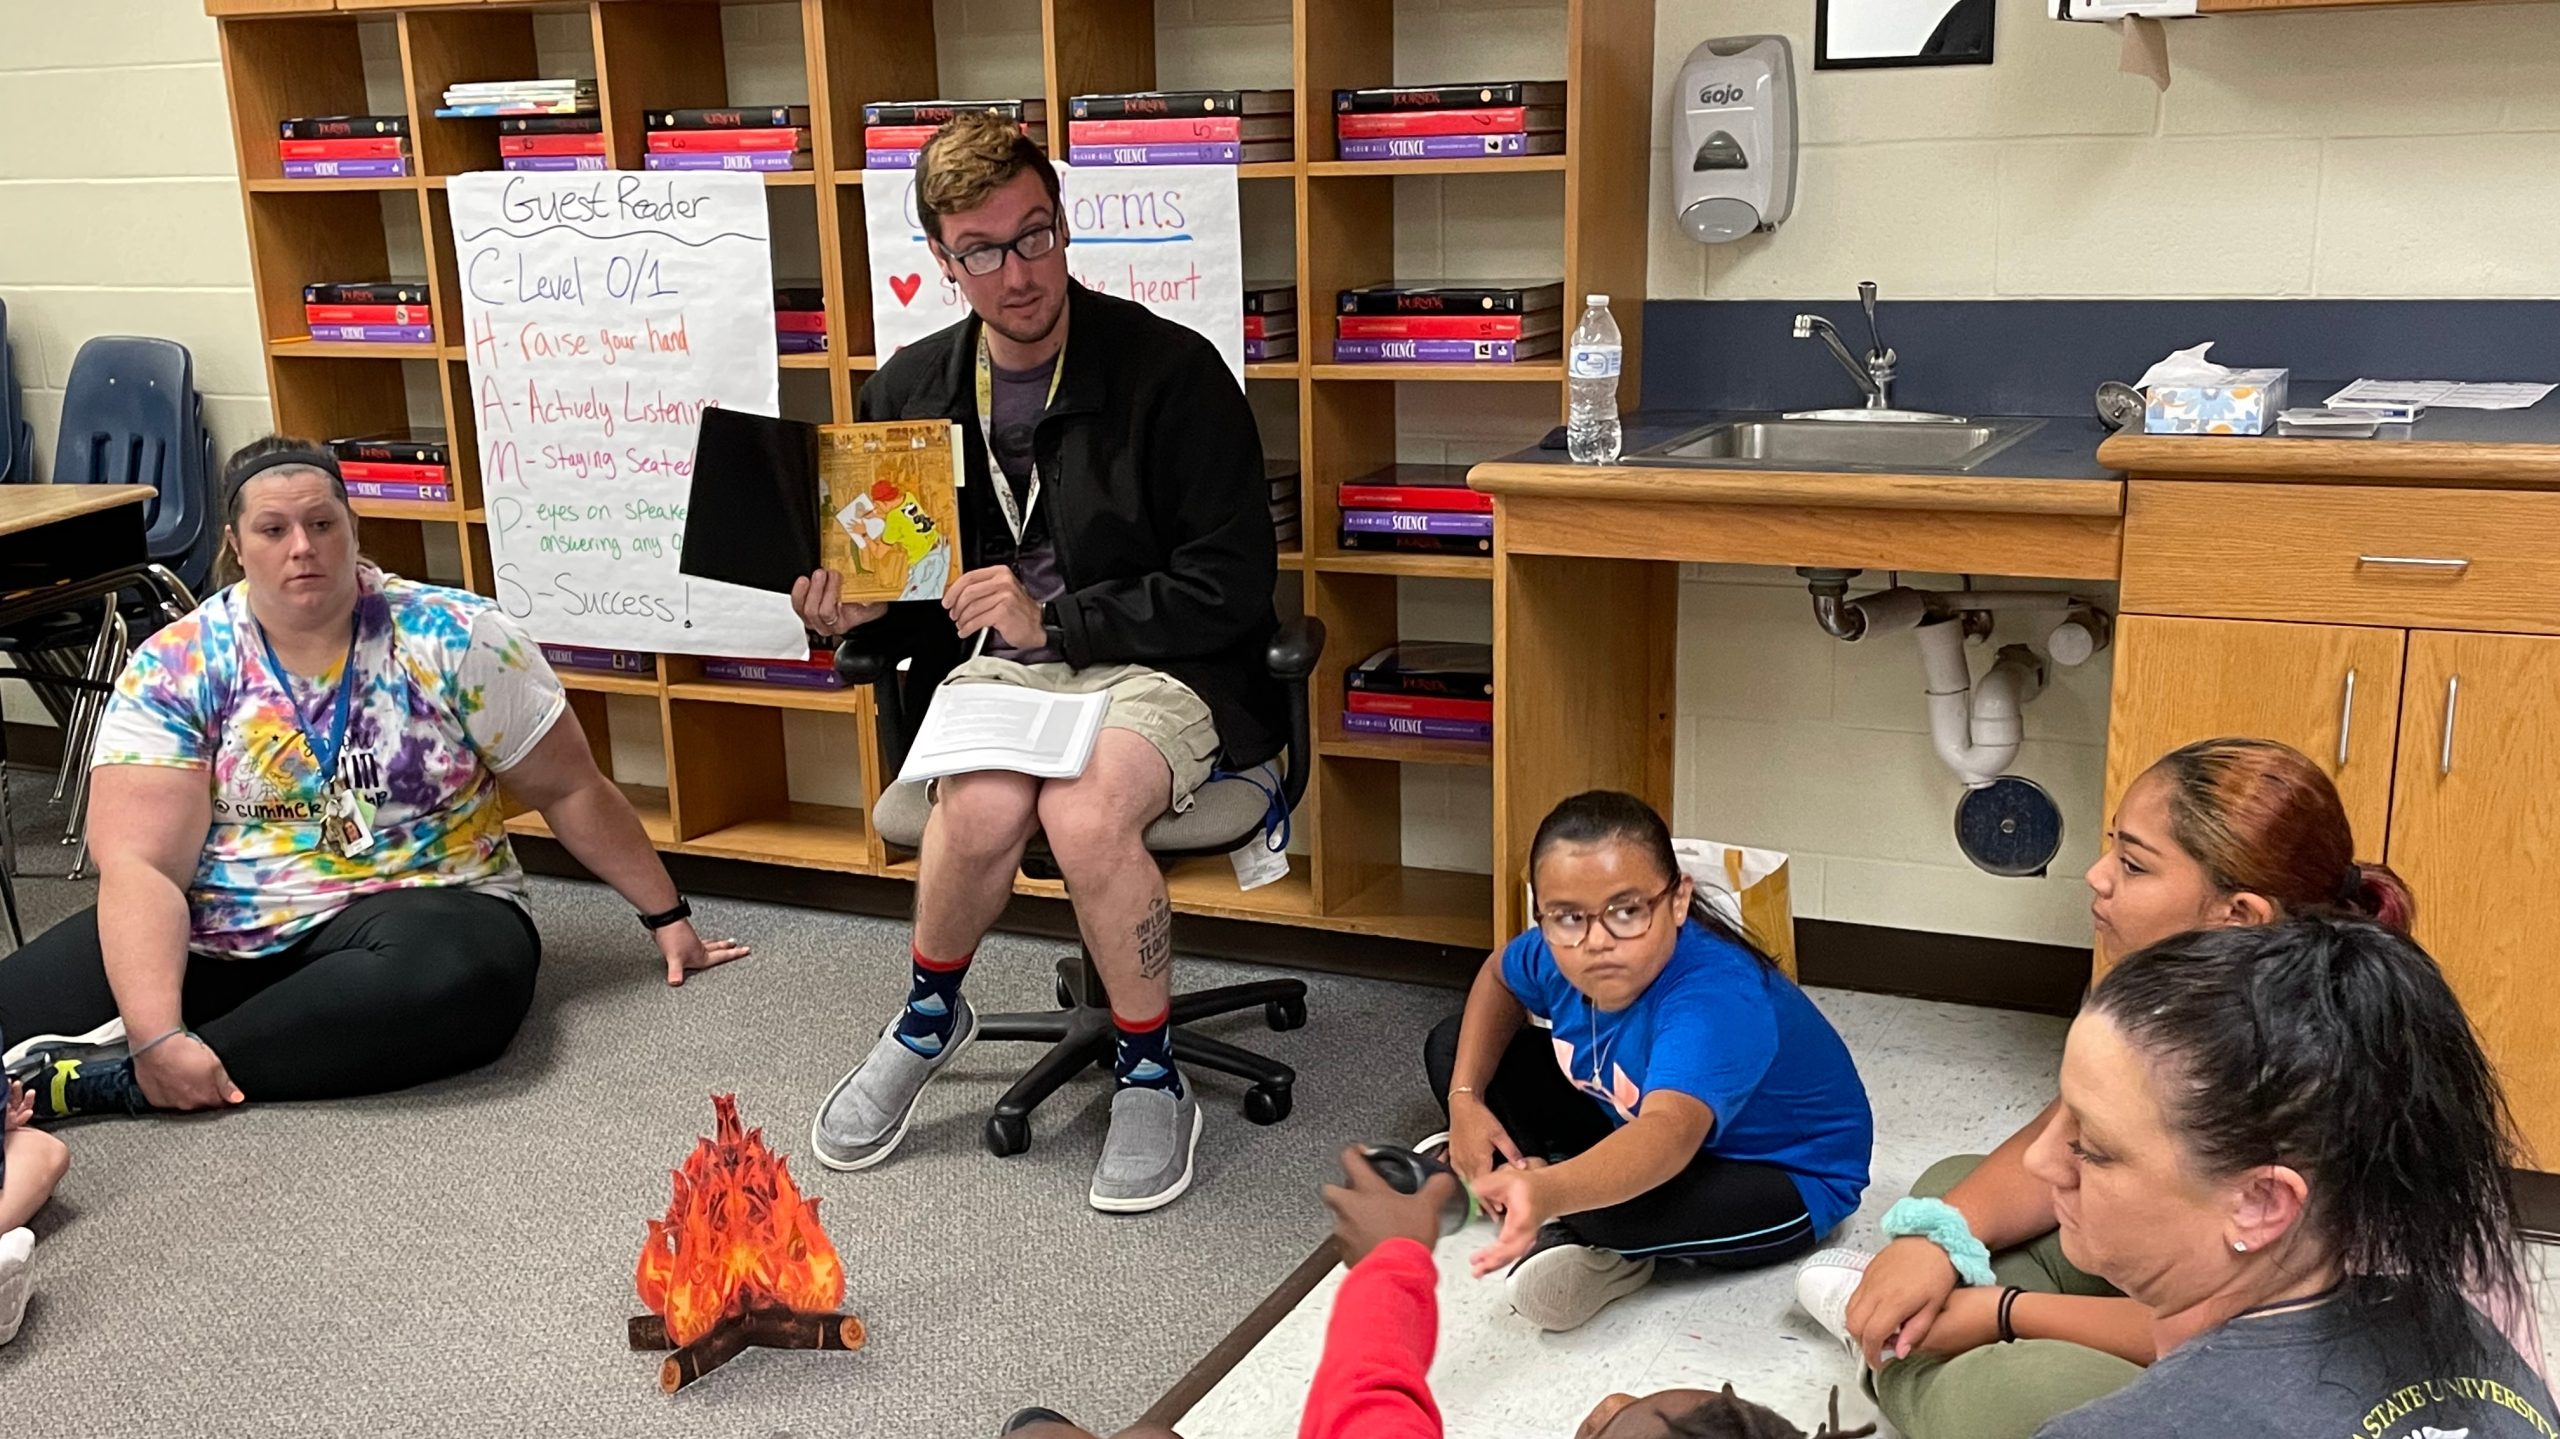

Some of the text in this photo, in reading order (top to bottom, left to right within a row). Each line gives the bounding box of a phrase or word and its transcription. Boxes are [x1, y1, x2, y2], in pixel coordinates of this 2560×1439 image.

[1113, 147, 1148, 163] SCIENCE
[1388, 139, 1425, 156] SCIENCE
[503, 176, 711, 223] Guest Reader
[1129, 261, 1202, 303] heart
[600, 328, 637, 365] your
[645, 313, 690, 356] hand
[1381, 341, 1417, 359] SCIENCE
[624, 381, 719, 425] Listenin
[626, 447, 696, 477] Seated
[536, 503, 580, 531] eyes
[588, 504, 612, 520] on
[1392, 515, 1429, 531] SCIENCE
[540, 535, 622, 560] answering
[633, 537, 663, 559] any
[1389, 717, 1424, 734] SCIENCE
[2362, 1376, 2559, 1439] STATE UNIVERSITY
